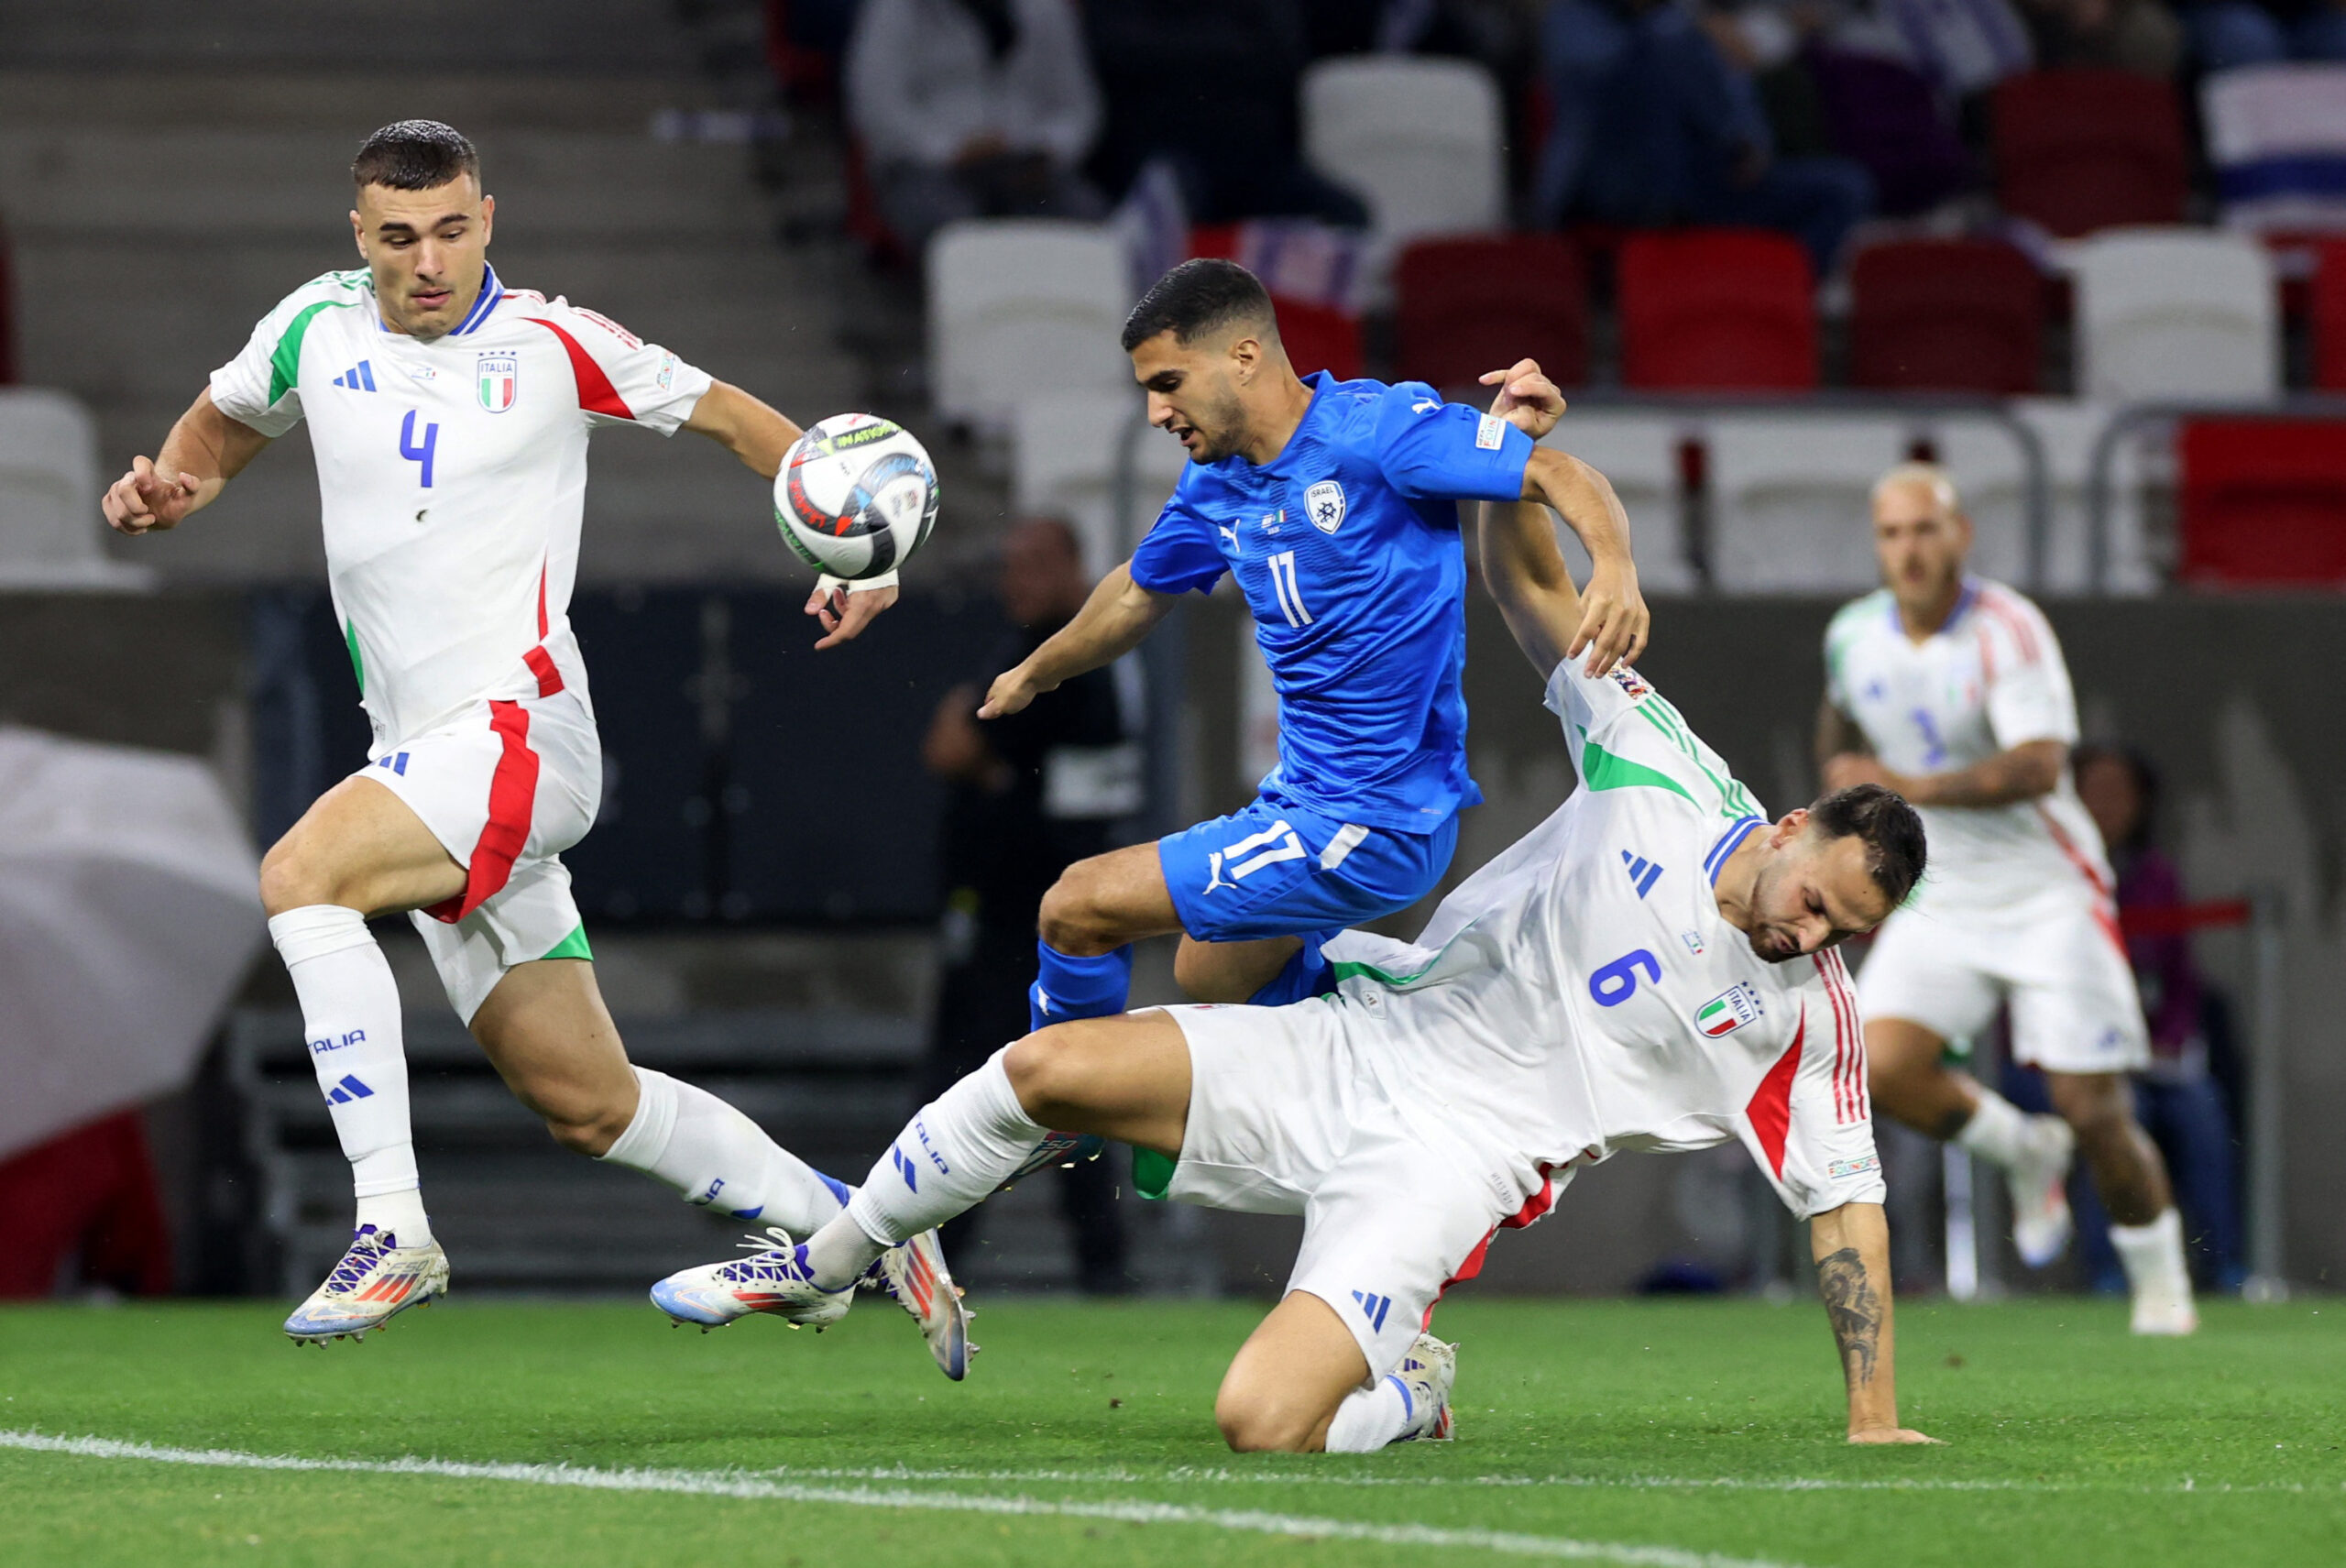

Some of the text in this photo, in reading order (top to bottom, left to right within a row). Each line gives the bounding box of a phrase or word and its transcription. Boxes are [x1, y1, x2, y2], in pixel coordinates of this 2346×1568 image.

[480, 363, 513, 372] ITALIA
[399, 409, 440, 488] 4
[1310, 485, 1334, 498] ISRAEL
[1589, 948, 1661, 1007] 6
[1727, 991, 1750, 1022] ITALIA
[387, 1259, 430, 1273] F50
